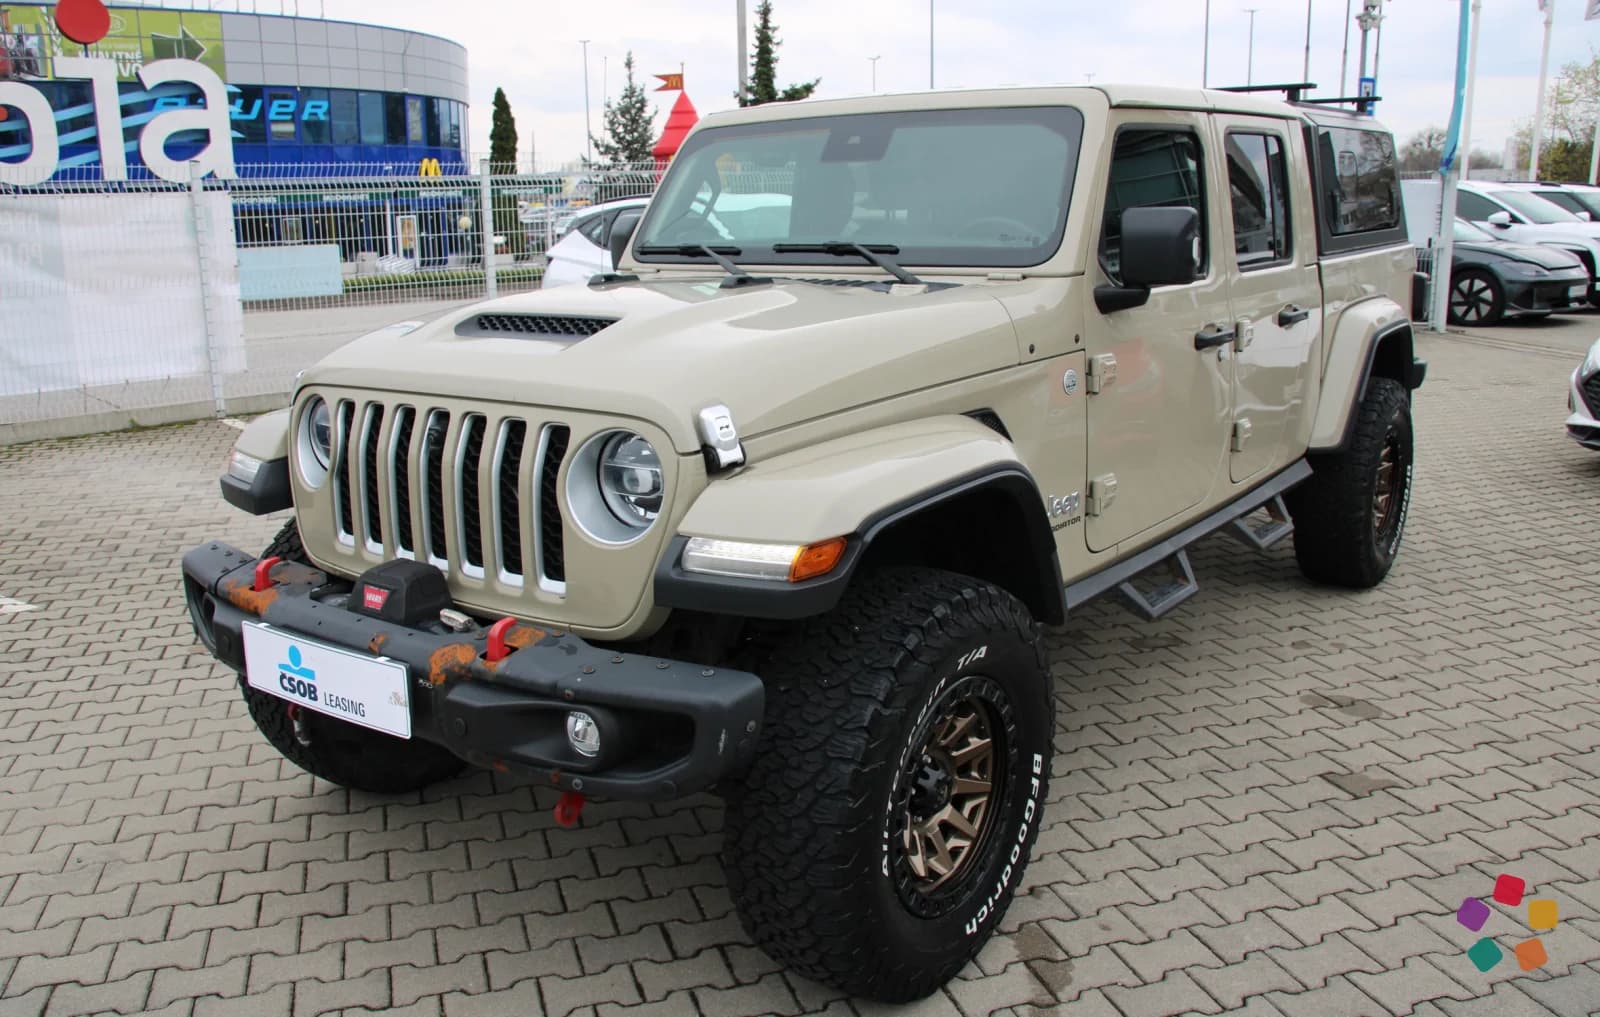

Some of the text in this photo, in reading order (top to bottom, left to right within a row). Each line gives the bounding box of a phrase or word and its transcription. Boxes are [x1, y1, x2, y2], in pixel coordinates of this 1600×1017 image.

[1047, 490, 1080, 518] Jeep
[956, 644, 988, 673] T/A
[279, 671, 366, 718] ČSOB LEASING
[965, 752, 1043, 937] BFGoodrich
